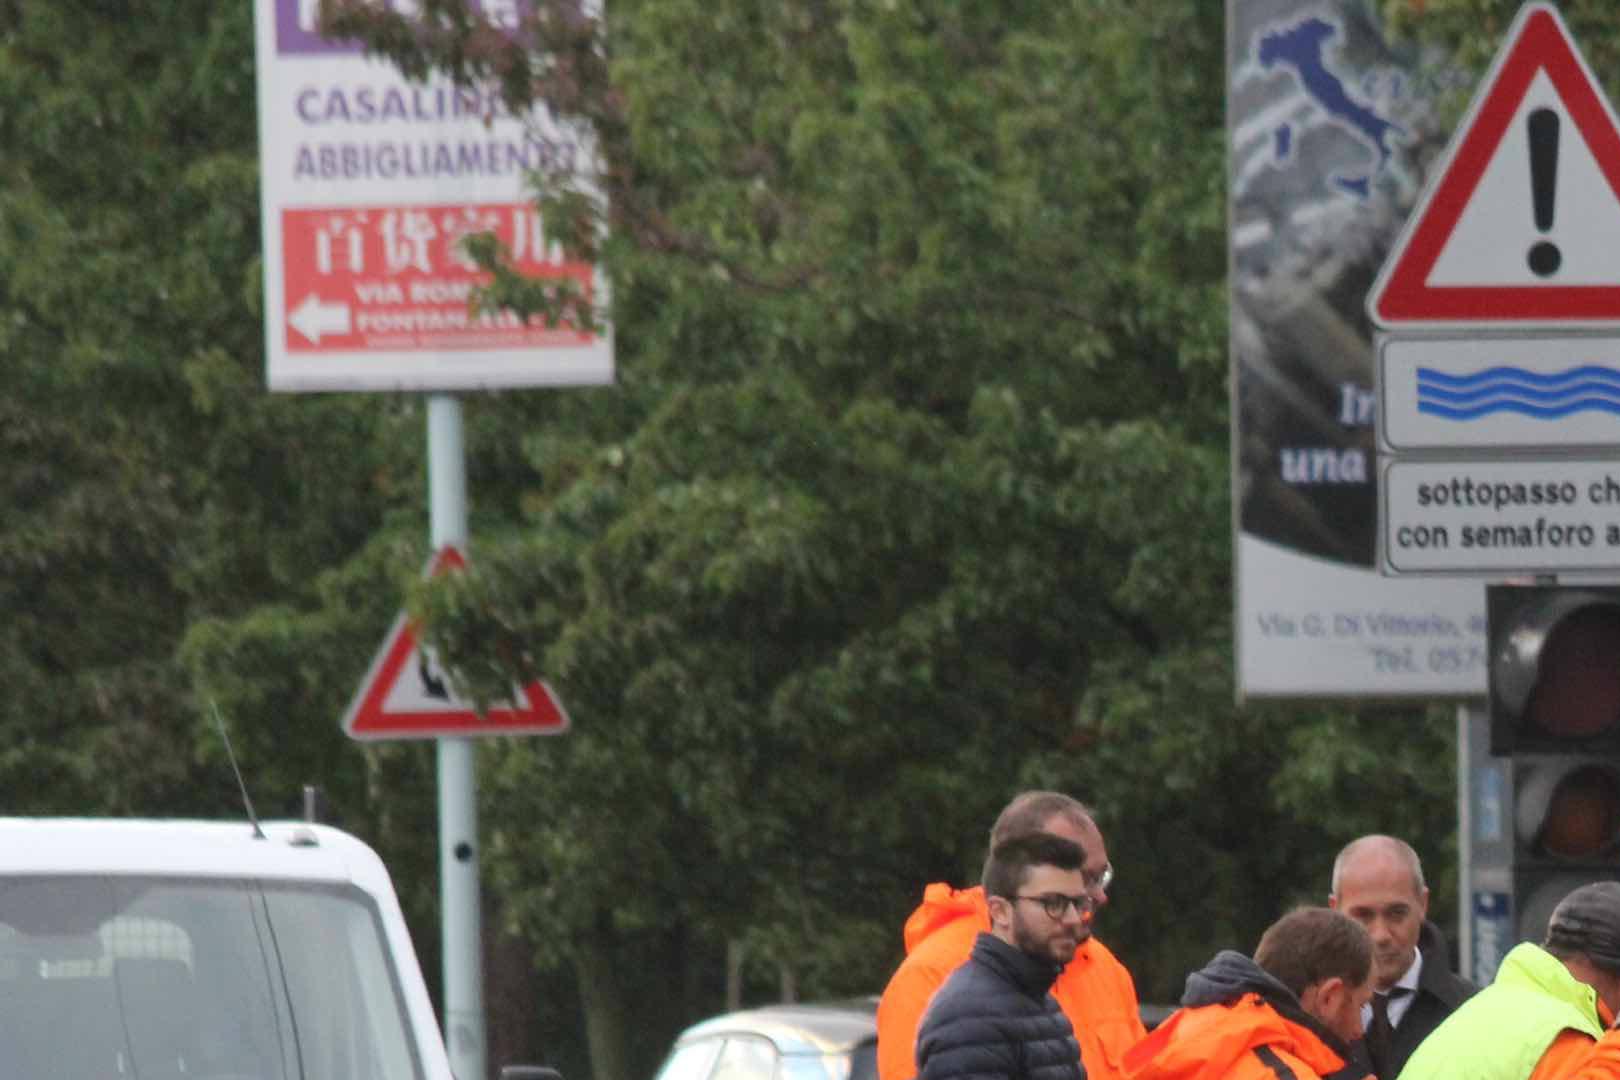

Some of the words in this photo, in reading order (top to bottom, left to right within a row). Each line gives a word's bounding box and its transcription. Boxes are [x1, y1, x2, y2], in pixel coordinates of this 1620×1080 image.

[1281, 448, 1366, 483] una
[1417, 476, 1577, 510] sottopasso
[1397, 526, 1448, 548] con
[1461, 517, 1595, 548] semaforo
